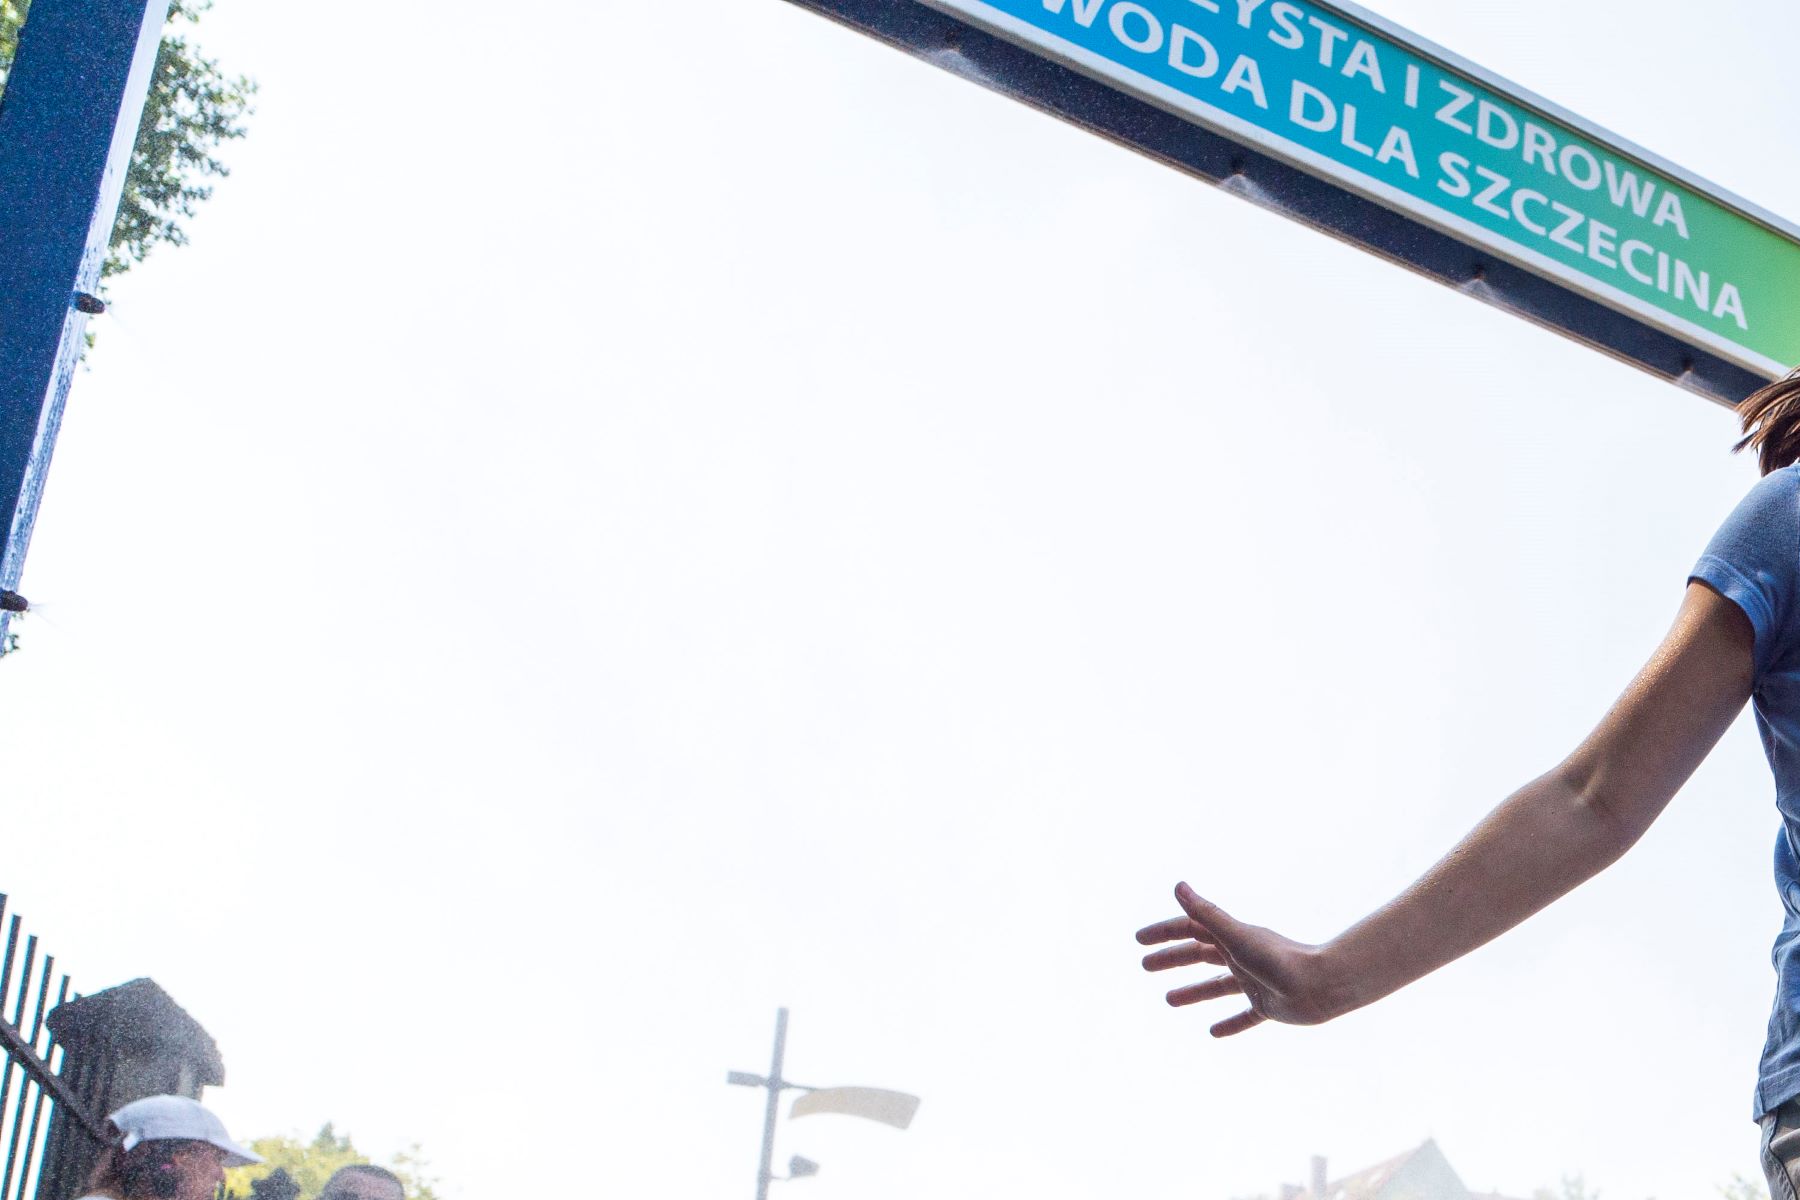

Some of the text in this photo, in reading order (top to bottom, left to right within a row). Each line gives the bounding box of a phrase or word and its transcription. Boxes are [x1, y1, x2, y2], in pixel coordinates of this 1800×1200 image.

[1188, 0, 1690, 241] YSTA I ZDROWA
[1288, 79, 1420, 179] DLA
[1436, 151, 1749, 332] SZCZECINA
